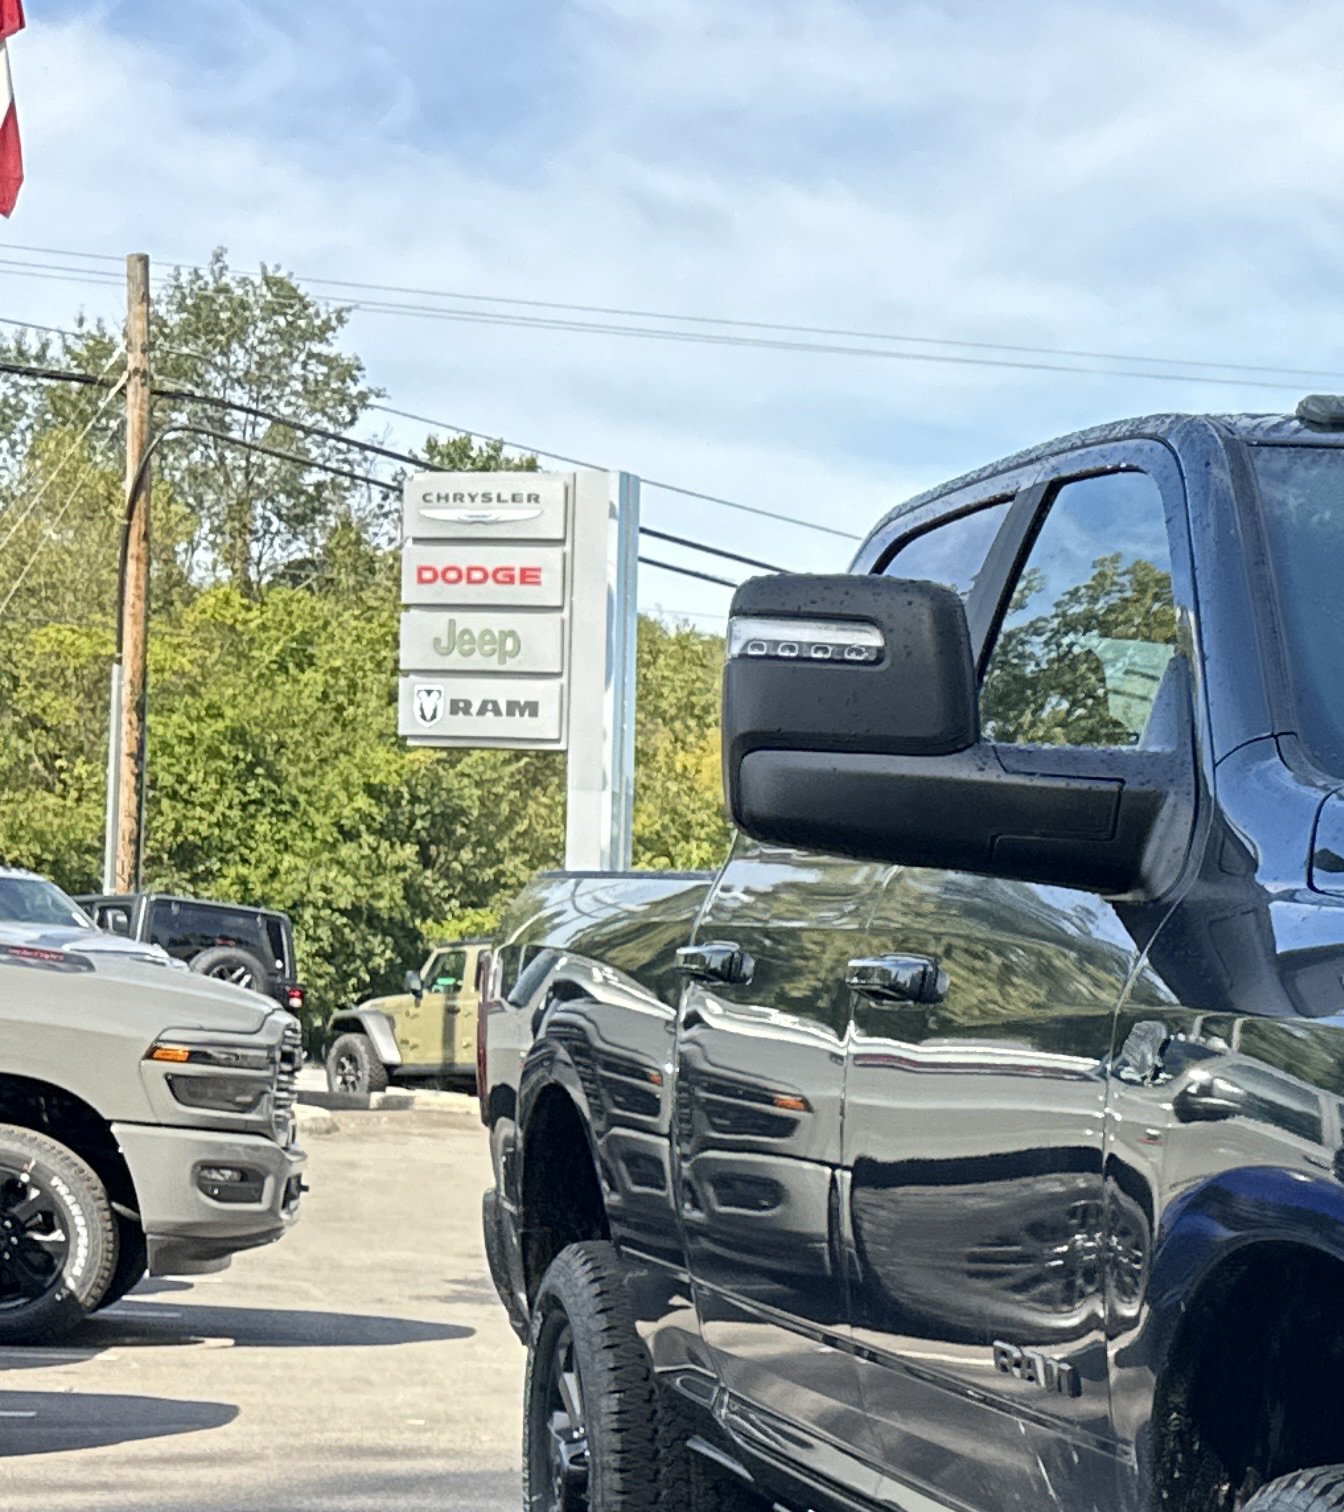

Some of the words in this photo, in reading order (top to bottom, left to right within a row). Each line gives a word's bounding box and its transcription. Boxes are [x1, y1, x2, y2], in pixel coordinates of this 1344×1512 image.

[421, 491, 541, 505] CHRYSLER
[416, 565, 543, 586] DODGE
[432, 618, 521, 666] Jeep
[449, 698, 539, 718] RAM
